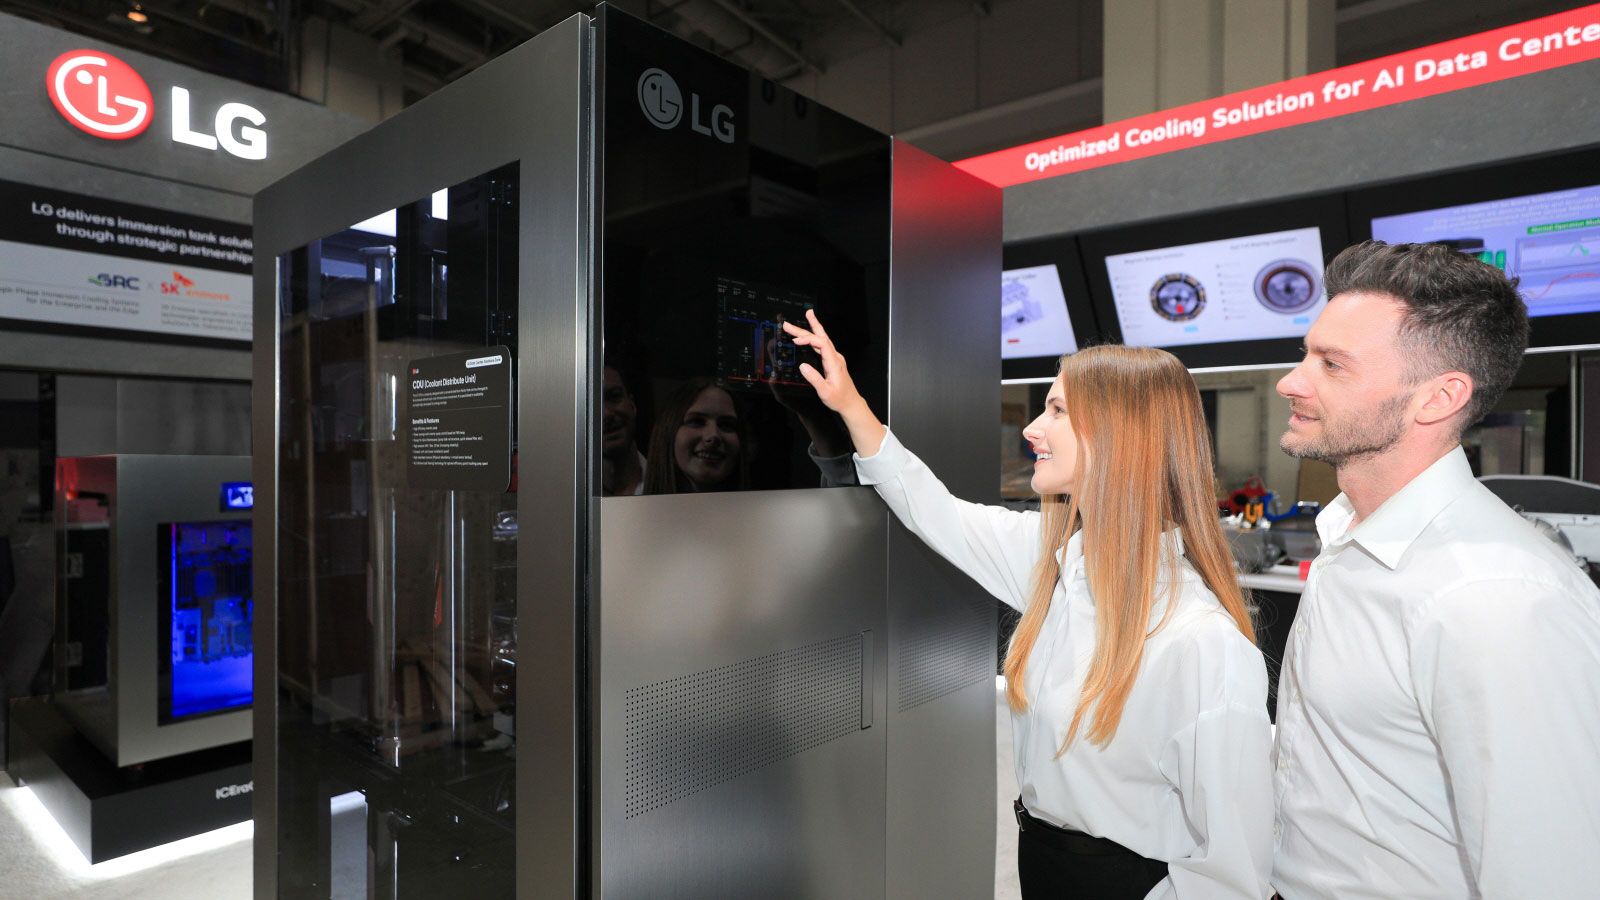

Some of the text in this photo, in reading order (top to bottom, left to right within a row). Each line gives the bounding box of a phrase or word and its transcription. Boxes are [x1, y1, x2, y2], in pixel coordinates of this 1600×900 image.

[691, 92, 736, 144] LG
[1024, 22, 1600, 172] Optimized Cooling Solution for AI Data Cente
[171, 85, 268, 160] LG
[31, 201, 54, 216] LG
[56, 206, 115, 227] delivers
[117, 216, 187, 239] immersion
[188, 229, 217, 243] tank
[56, 222, 115, 243] through
[117, 233, 178, 252] strategic
[413, 380, 424, 389] CDU
[443, 376, 464, 386] Distribute
[465, 373, 476, 383] Unit)
